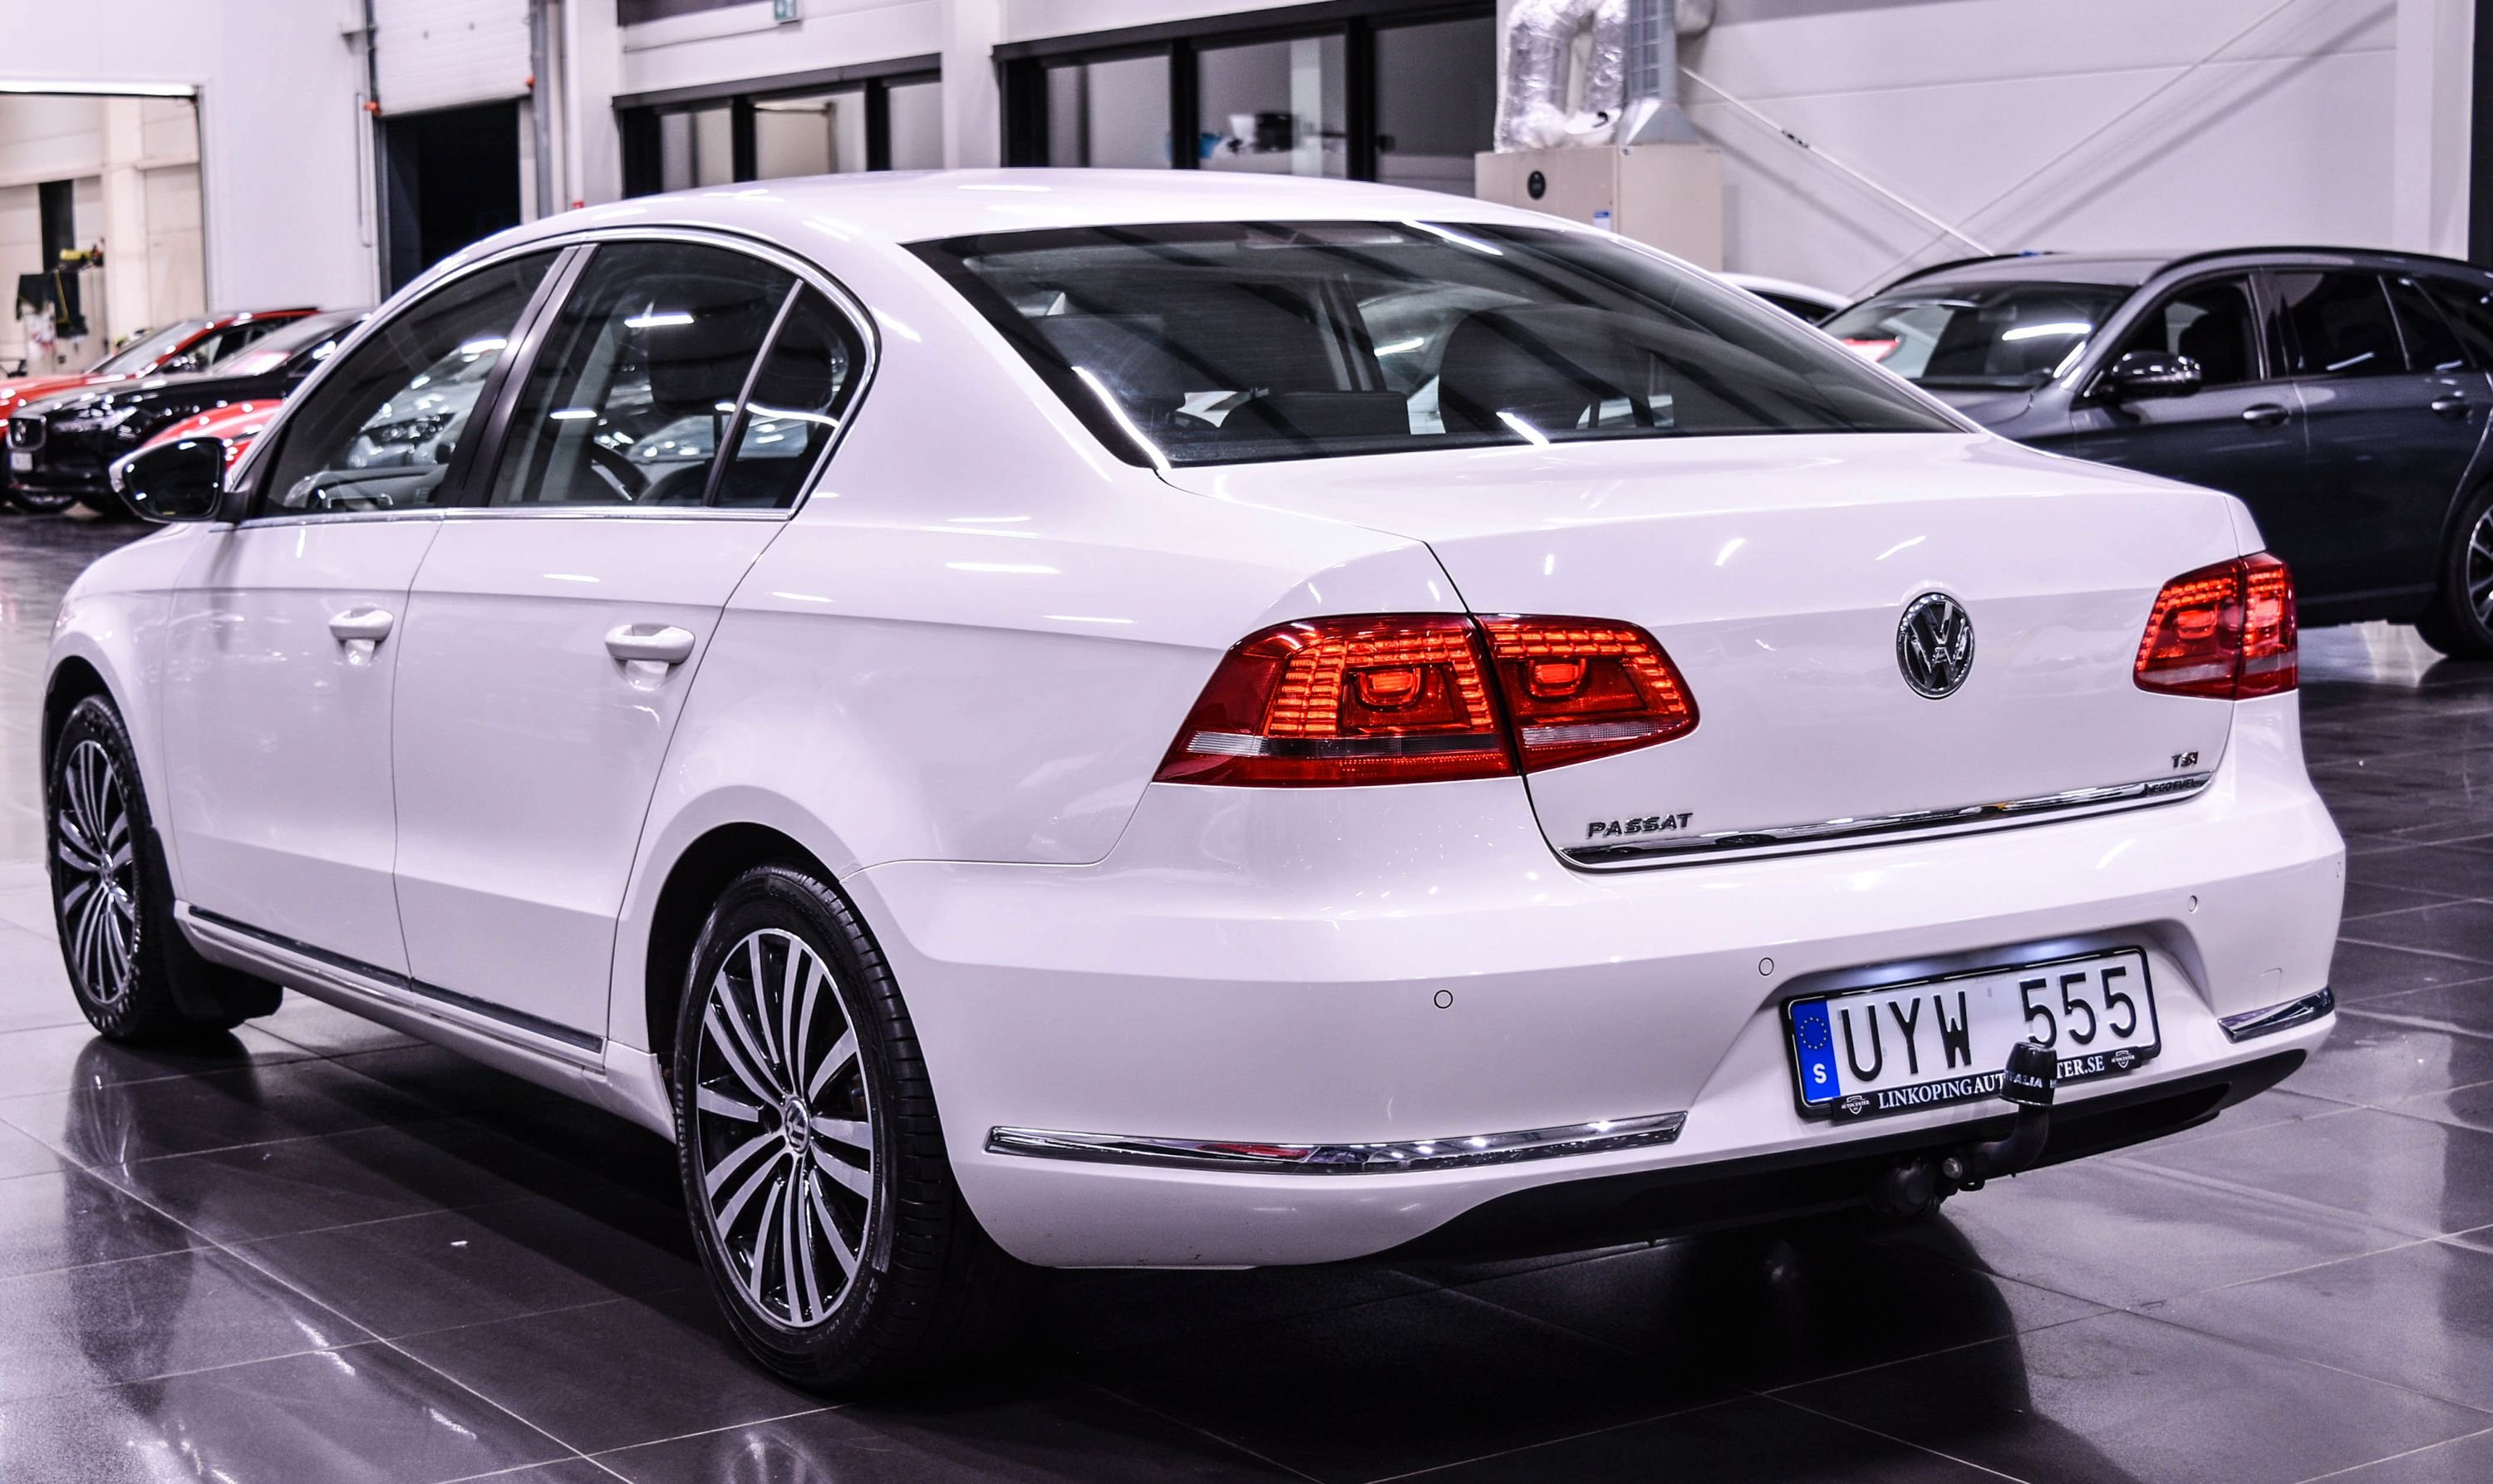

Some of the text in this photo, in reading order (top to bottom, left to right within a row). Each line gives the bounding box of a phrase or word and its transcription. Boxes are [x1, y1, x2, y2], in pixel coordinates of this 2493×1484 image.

[2171, 751, 2199, 768] TSI
[1586, 813, 1694, 839] PASSAT
[1840, 966, 2137, 1082] UYW 555
[1812, 1063, 1827, 1084] S
[1878, 1054, 2105, 1109] LINKOPINGAUTTER.SE
